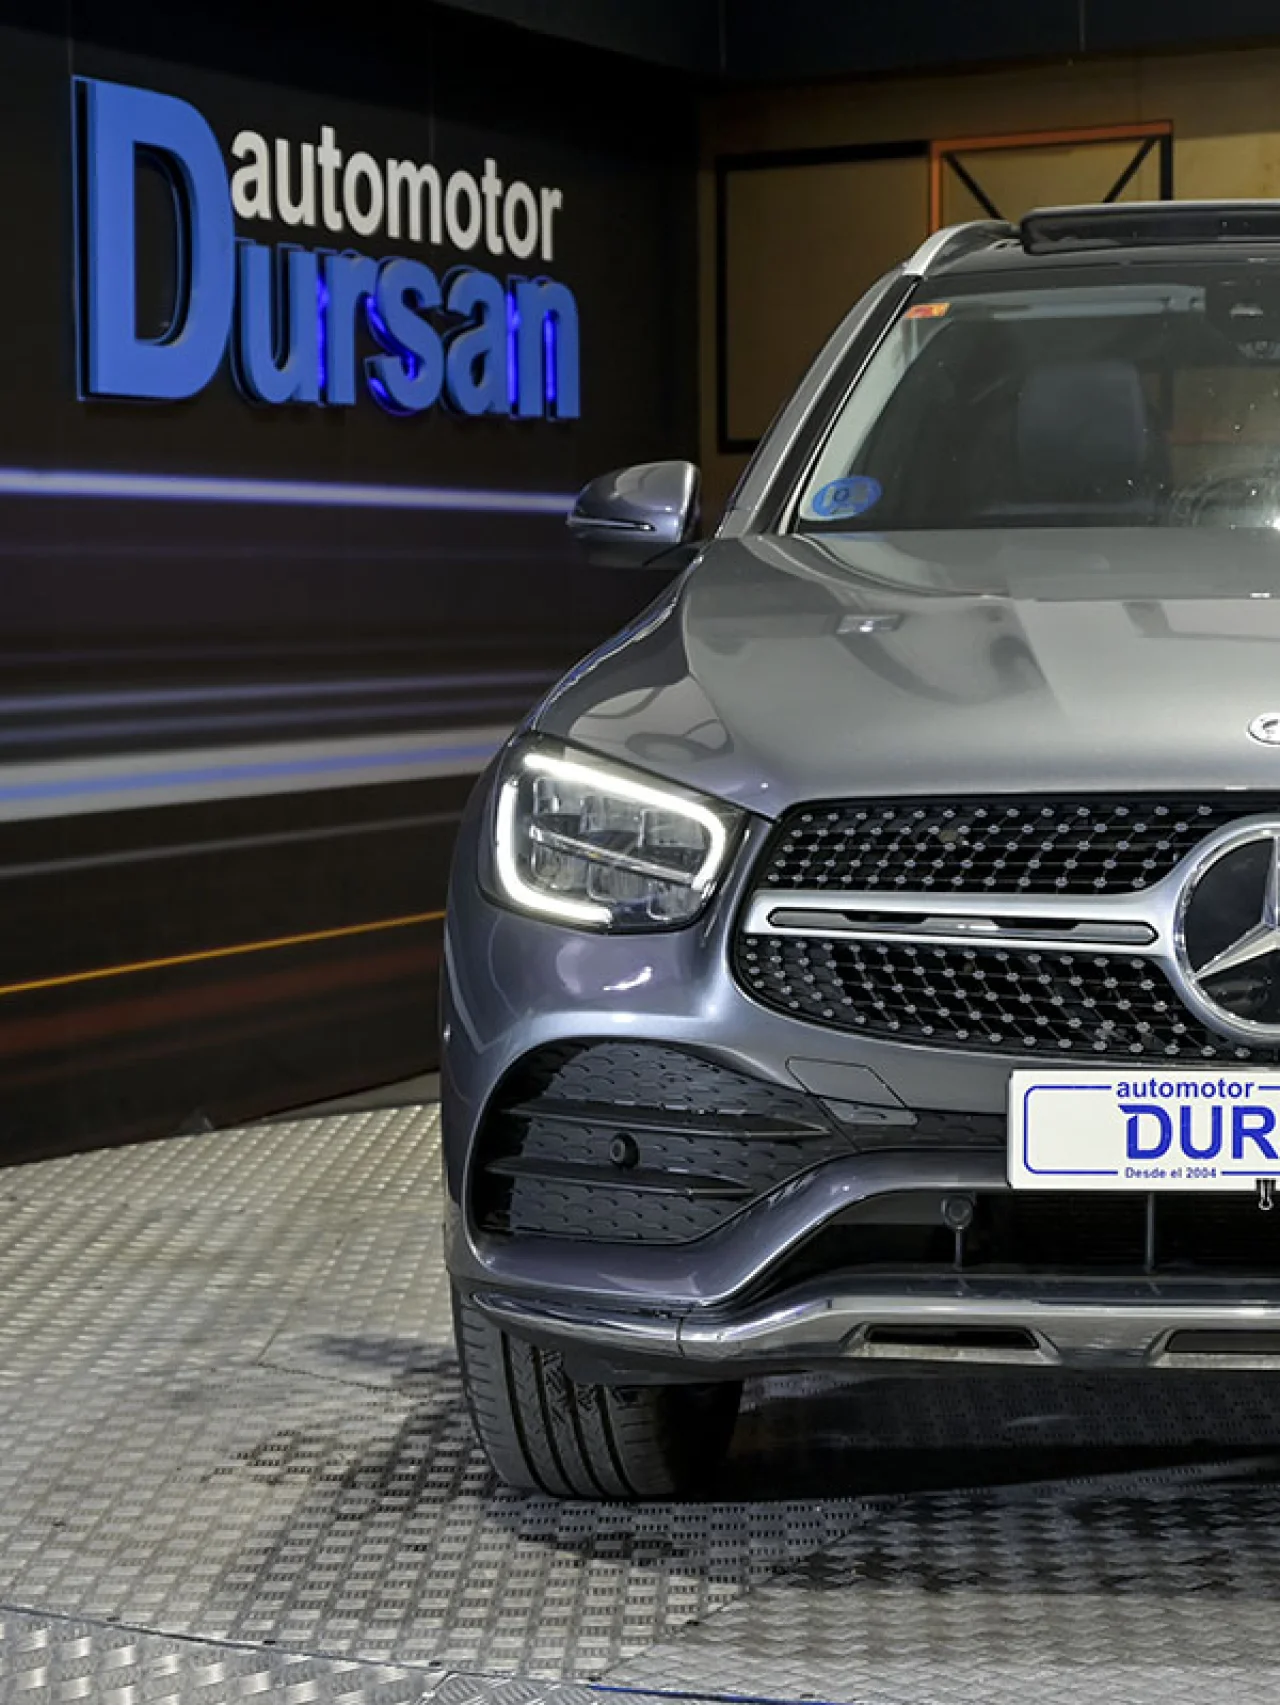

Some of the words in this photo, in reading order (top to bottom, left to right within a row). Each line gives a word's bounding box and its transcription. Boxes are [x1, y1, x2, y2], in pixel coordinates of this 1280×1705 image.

[231, 125, 563, 261] automotor
[72, 75, 581, 420] Dursan
[1116, 1077, 1255, 1099] automotor
[1124, 1167, 1167, 1179] Desde
[1170, 1167, 1182, 1179] el
[1185, 1167, 1218, 1179] 2004
